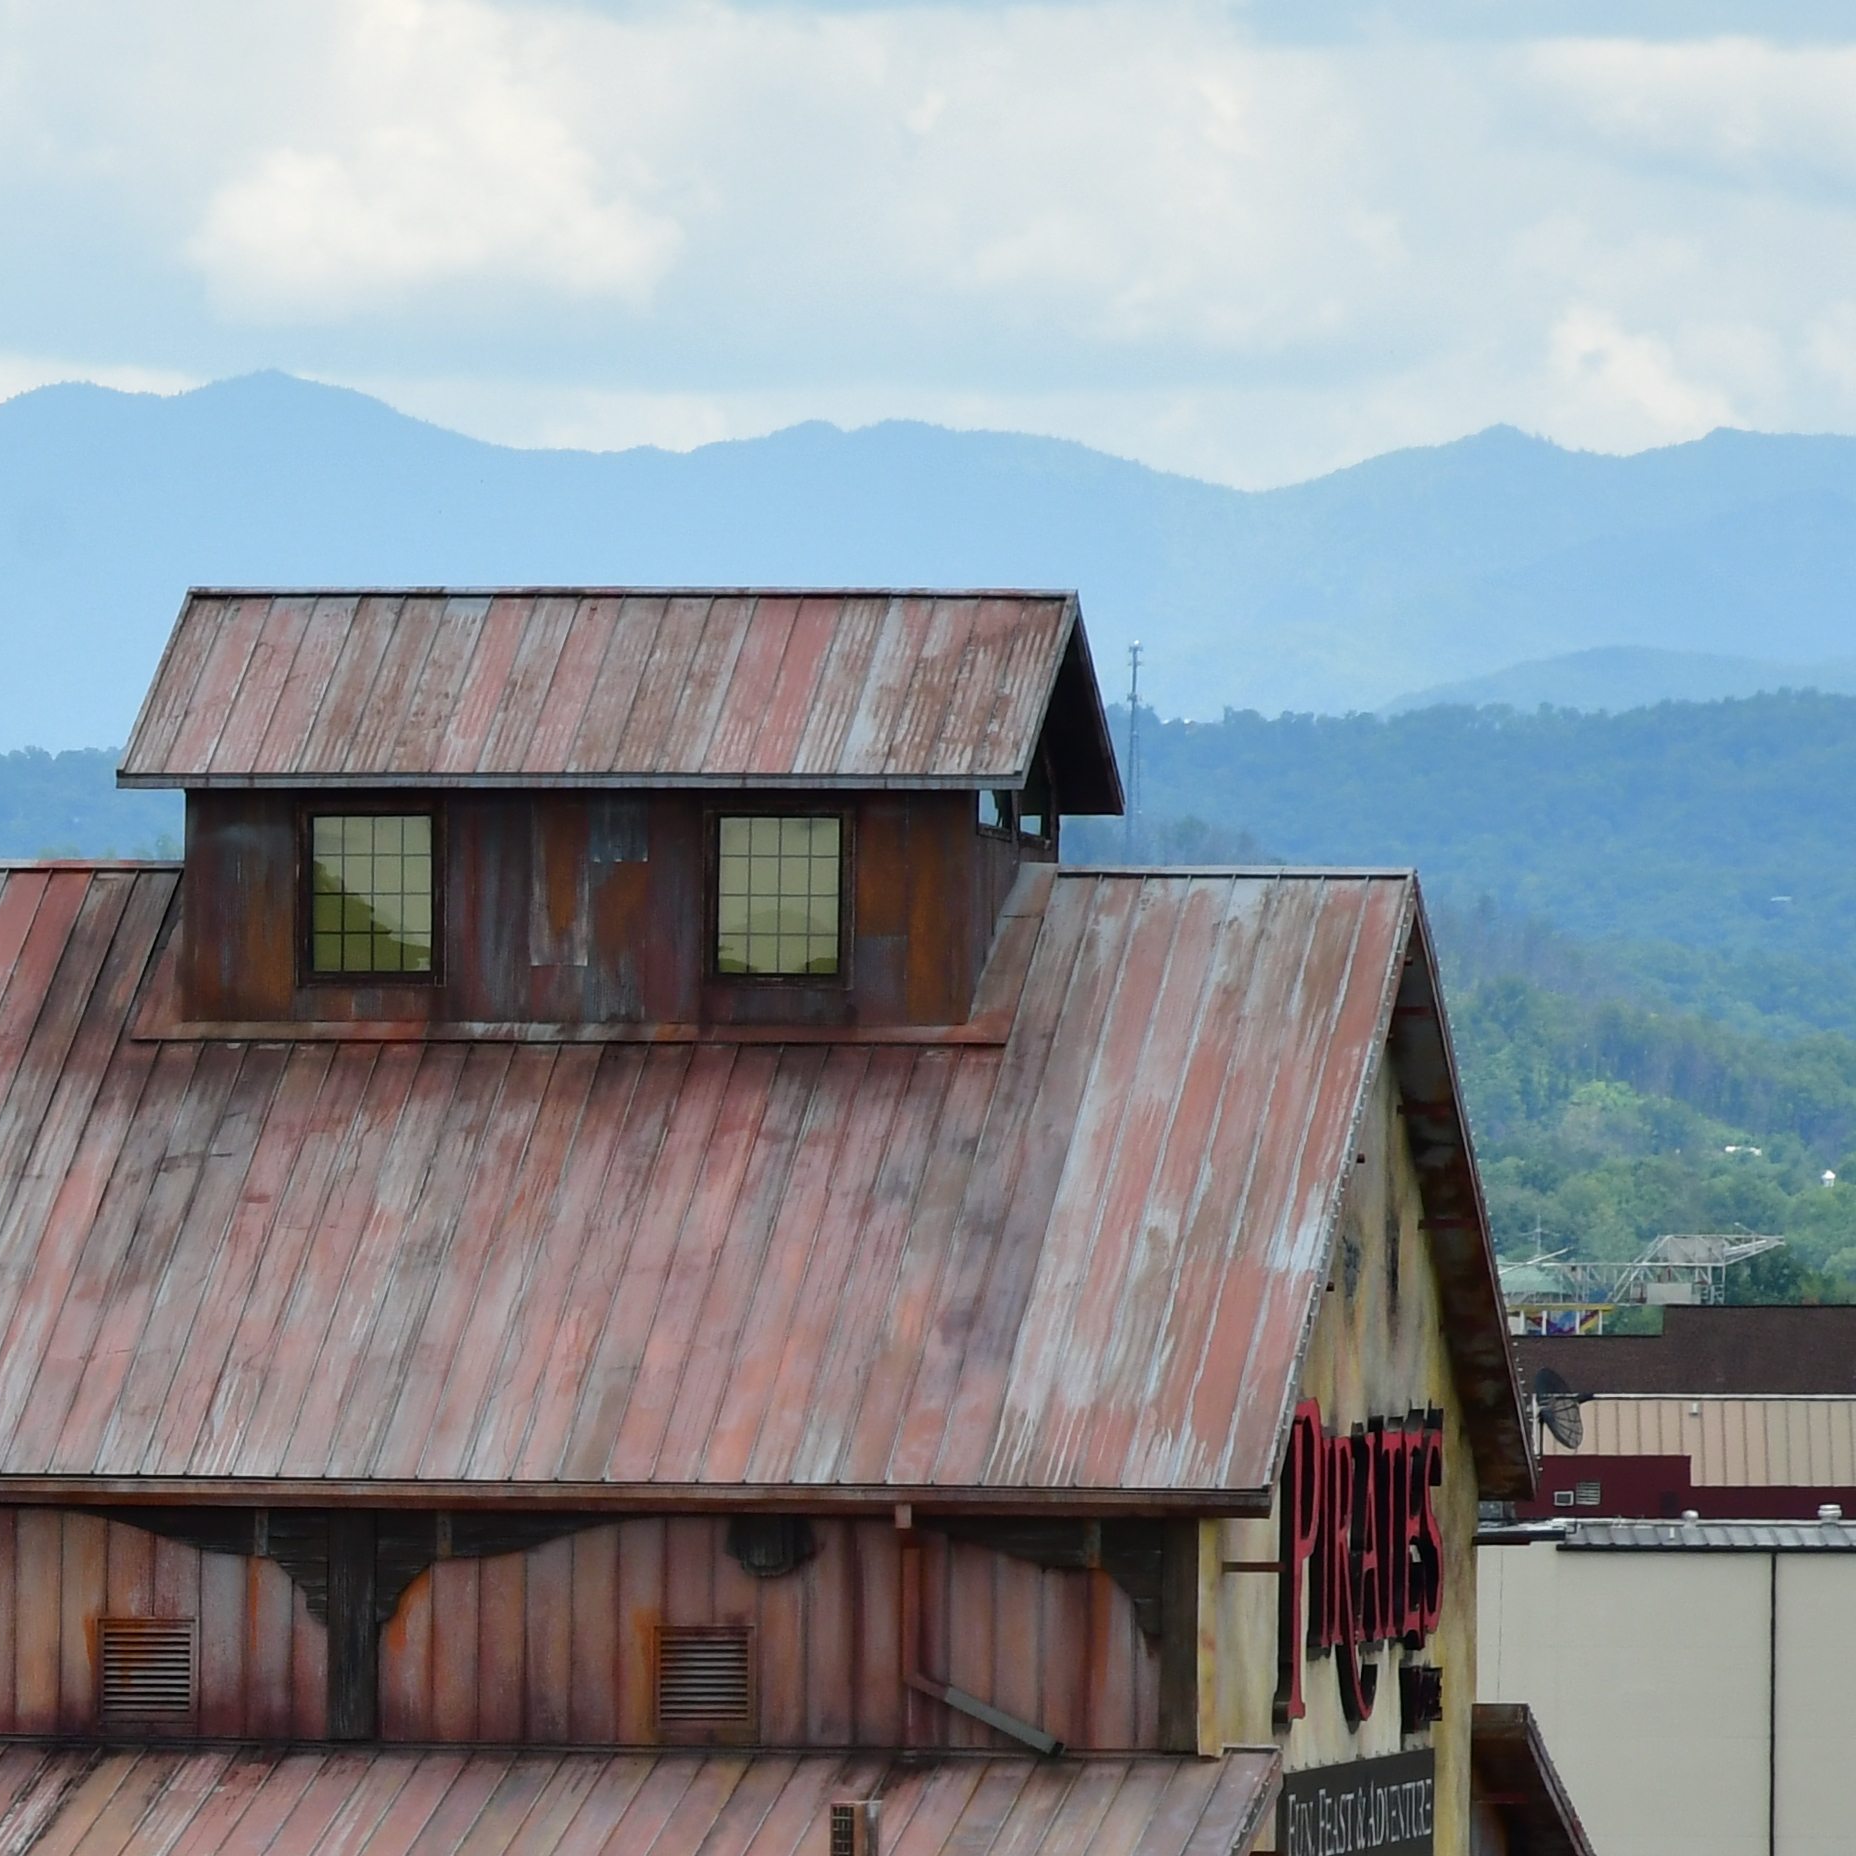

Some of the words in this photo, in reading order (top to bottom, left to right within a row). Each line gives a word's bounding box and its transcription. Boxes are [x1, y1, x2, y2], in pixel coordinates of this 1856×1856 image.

[1286, 1397, 1444, 1721] PIRATES
[1355, 1786, 1367, 1850] &
[1367, 1778, 1433, 1848] ADVENTURE
